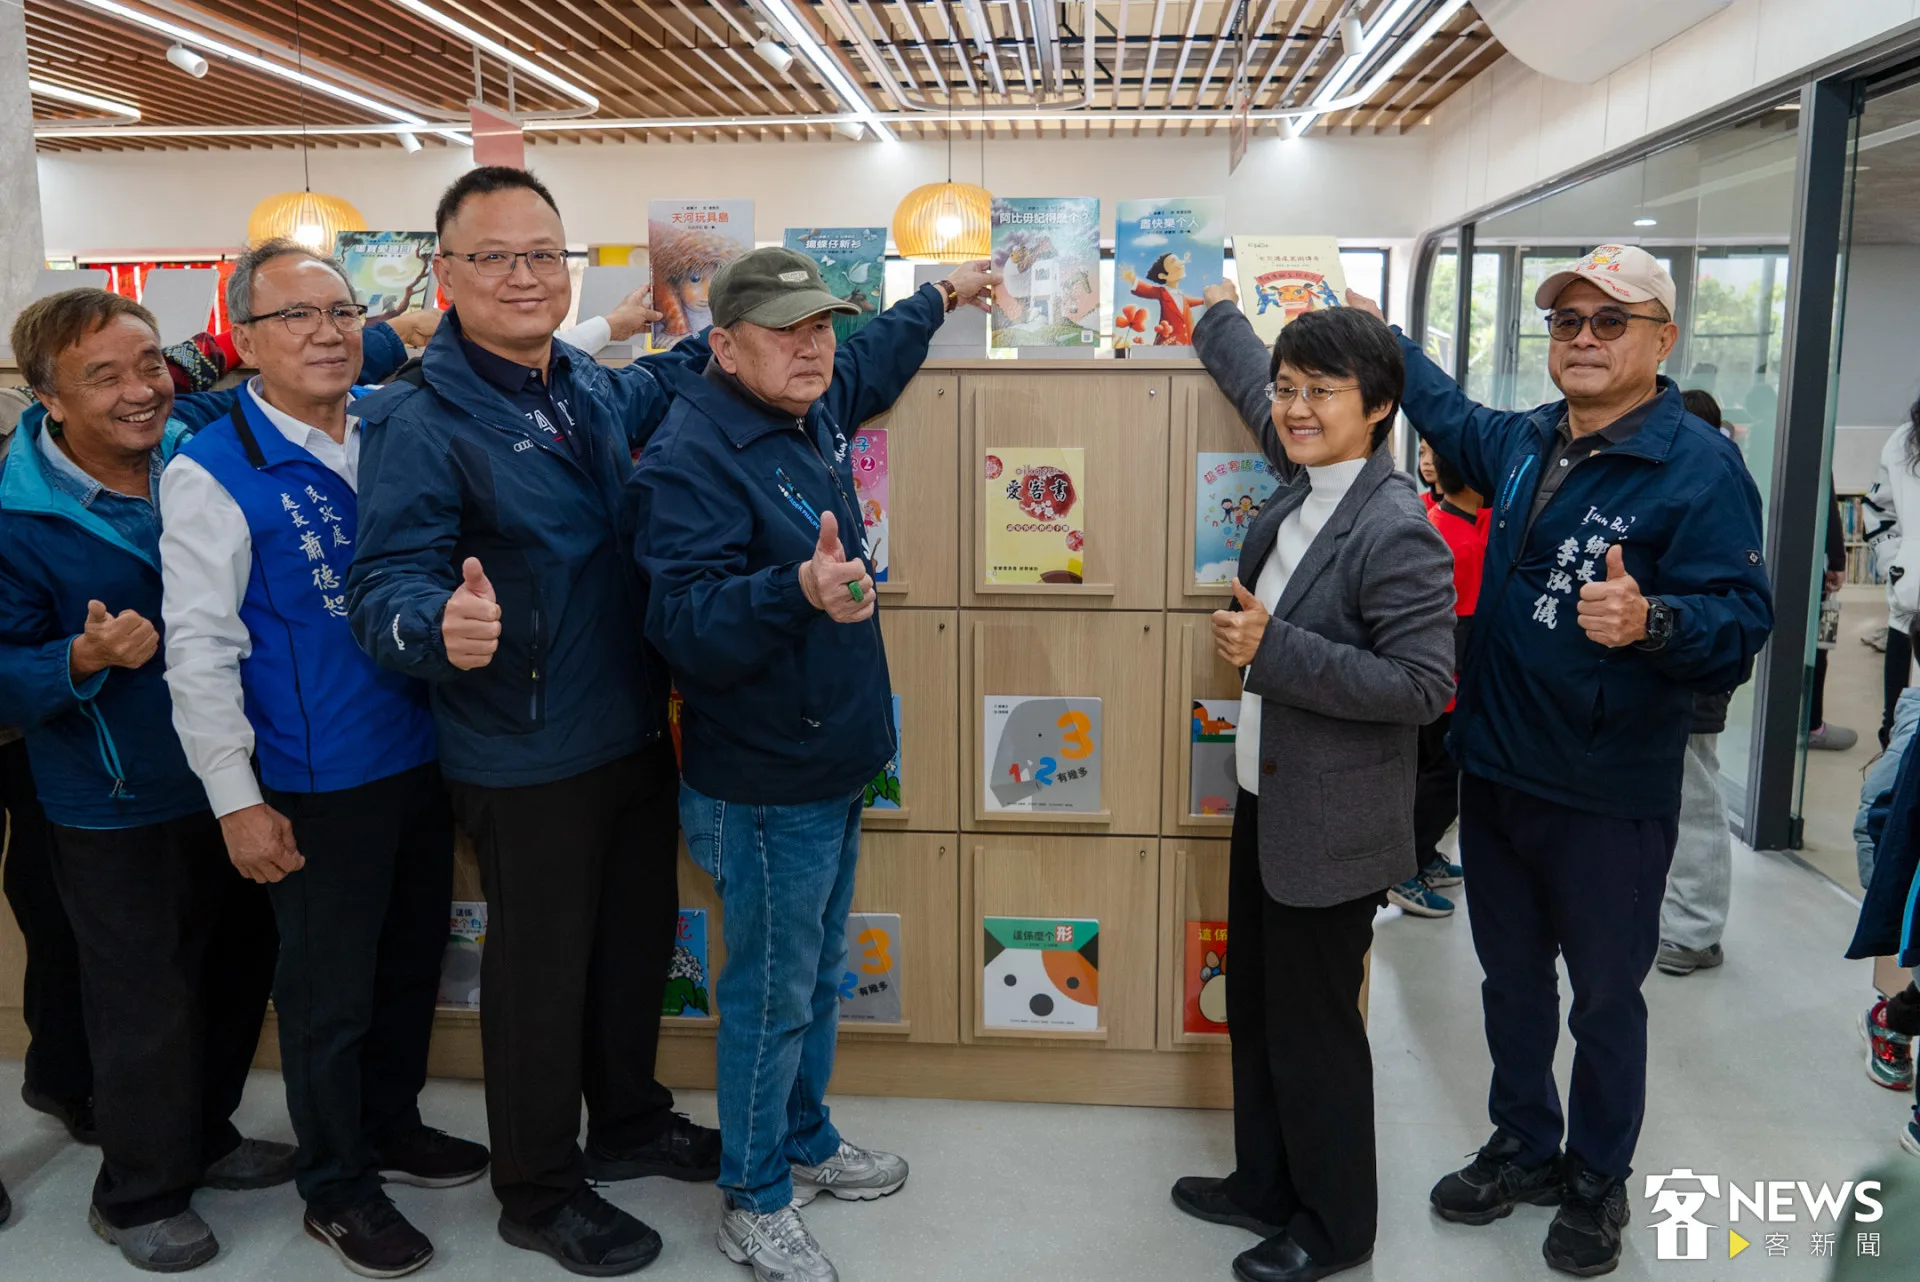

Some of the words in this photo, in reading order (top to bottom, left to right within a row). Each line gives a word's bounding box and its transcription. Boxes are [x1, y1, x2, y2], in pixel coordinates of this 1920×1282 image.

[671, 212, 729, 223] 天河玩具島
[1006, 478, 1068, 502] 愛客書
[304, 484, 351, 548] 民政處
[1056, 710, 1094, 760] 3
[1008, 763, 1021, 783] 1
[1034, 756, 1057, 786] 2
[856, 928, 893, 975] 3
